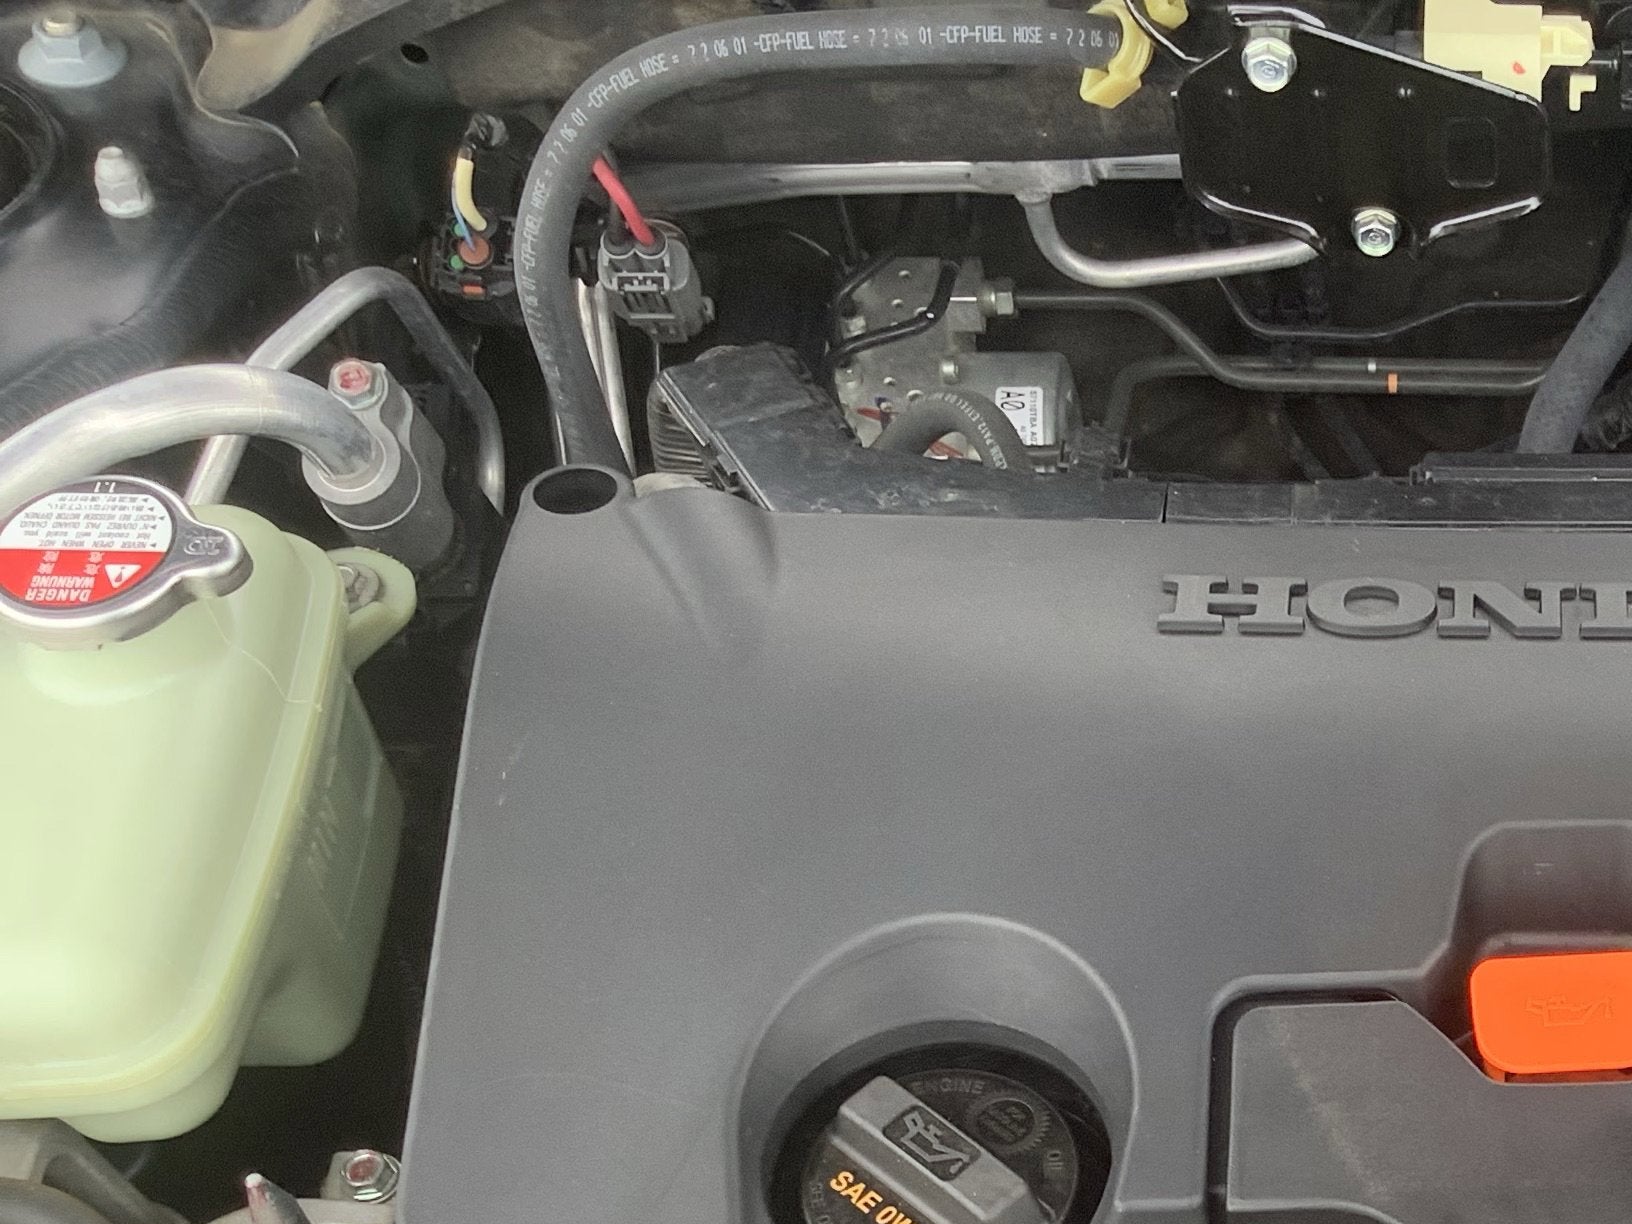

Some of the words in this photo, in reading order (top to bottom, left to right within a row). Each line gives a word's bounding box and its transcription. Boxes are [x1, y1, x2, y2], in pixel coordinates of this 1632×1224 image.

[639, 53, 669, 78] HOSE
[733, 36, 748, 55] 01
[819, 30, 847, 49] HOSE
[919, 27, 932, 44] 01
[1013, 26, 1043, 43] HOSE
[1091, 30, 1103, 47] 06
[94, 482, 117, 493] 1.1
[61, 540, 85, 548] WHEN
[92, 540, 115, 548] OPEN
[120, 540, 147, 549] NEVER
[30, 575, 96, 589] WARNUNG
[25, 588, 92, 602] DANGER
[911, 1077, 985, 1095] ENGINE
[829, 1171, 883, 1214] SAE
